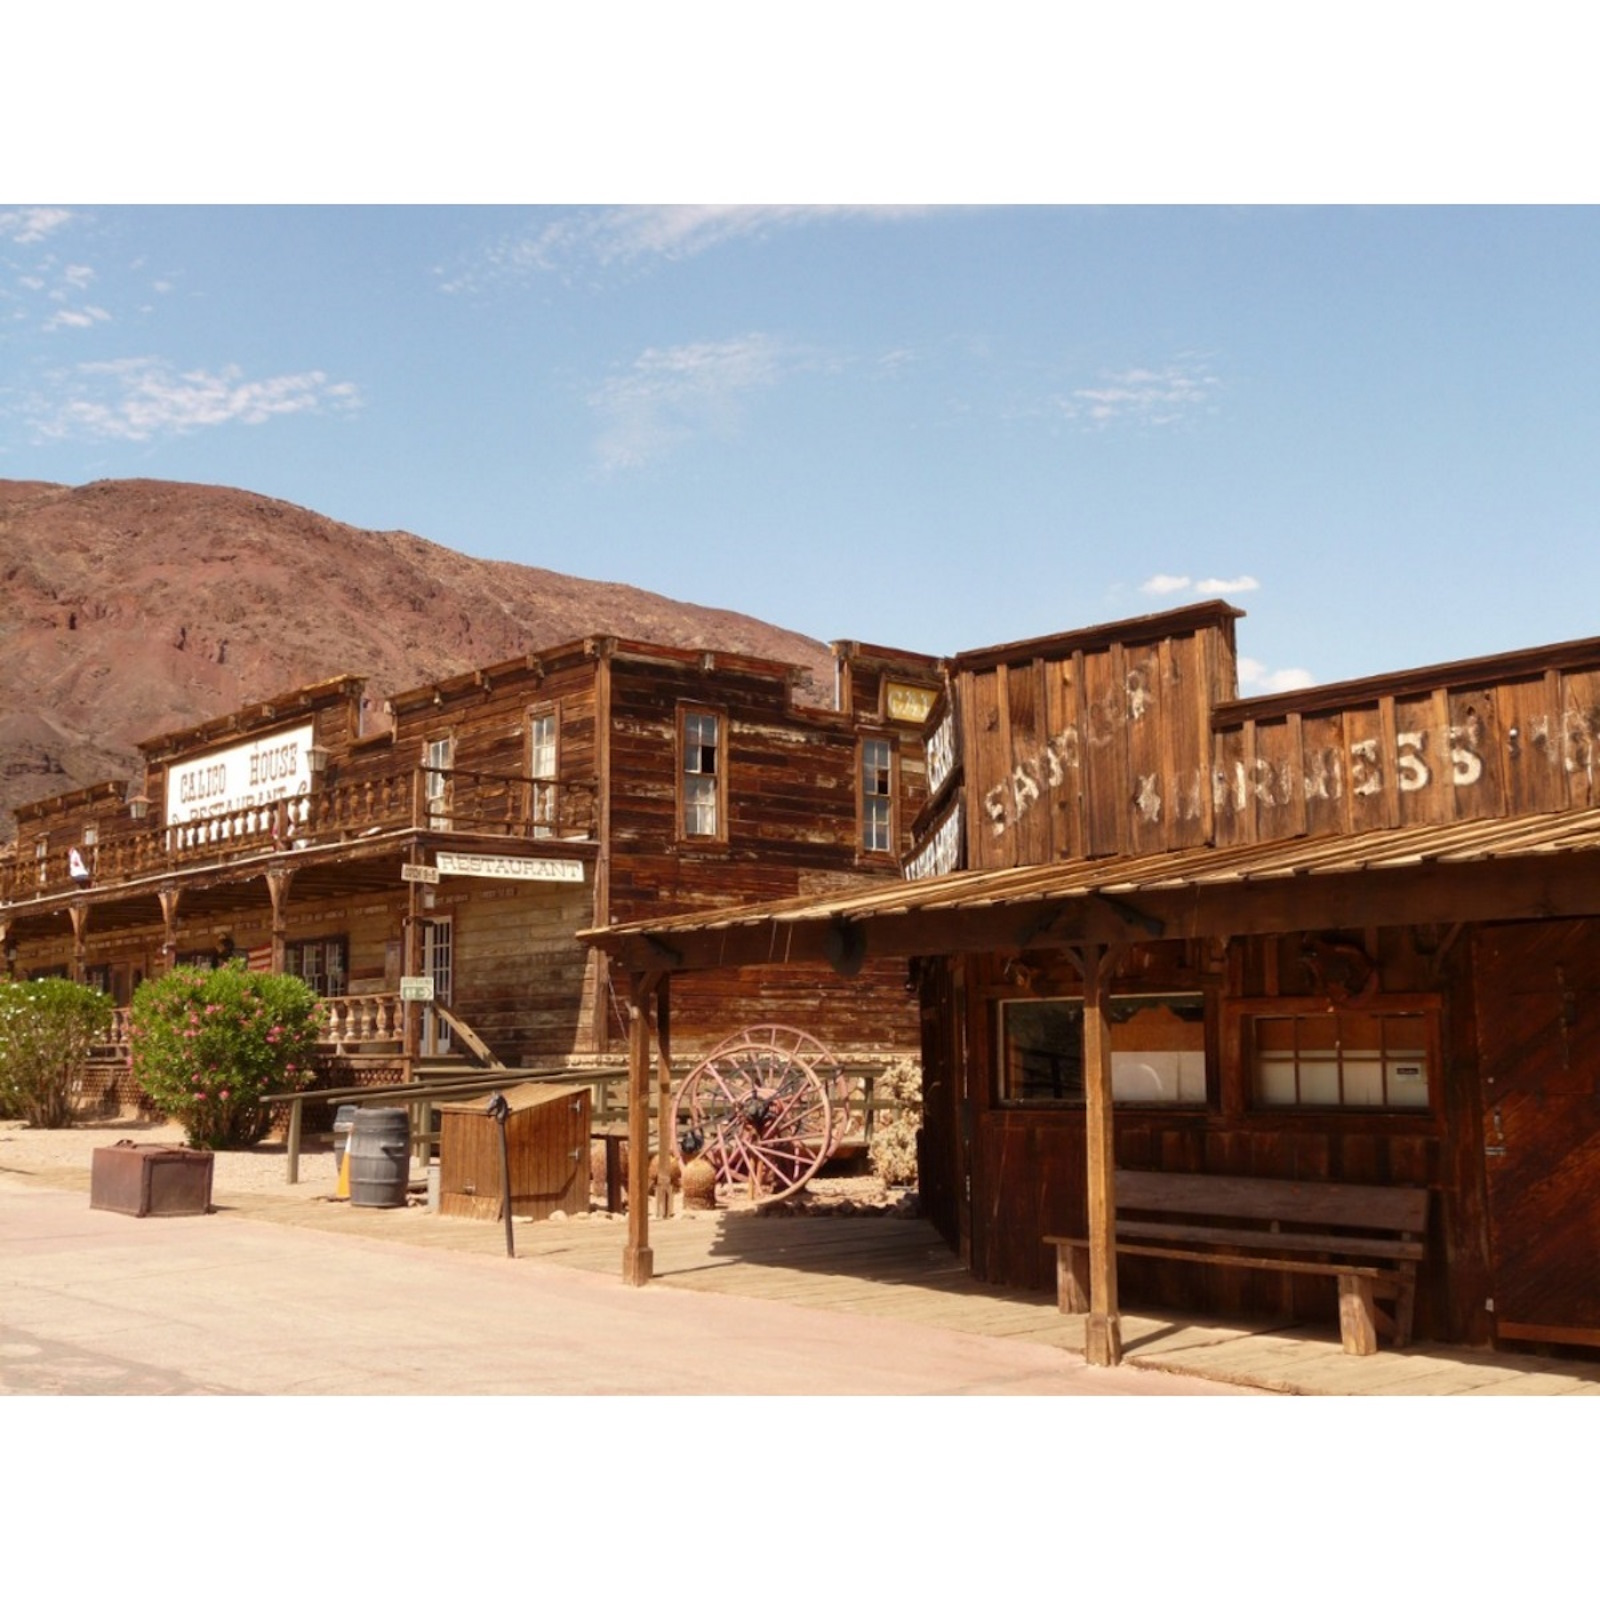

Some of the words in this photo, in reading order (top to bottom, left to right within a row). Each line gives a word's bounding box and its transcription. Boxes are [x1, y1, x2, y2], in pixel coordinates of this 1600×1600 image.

[180, 764, 226, 804] CALICO
[249, 742, 297, 787] HOUSE
[439, 855, 580, 877] RESTAURANT
